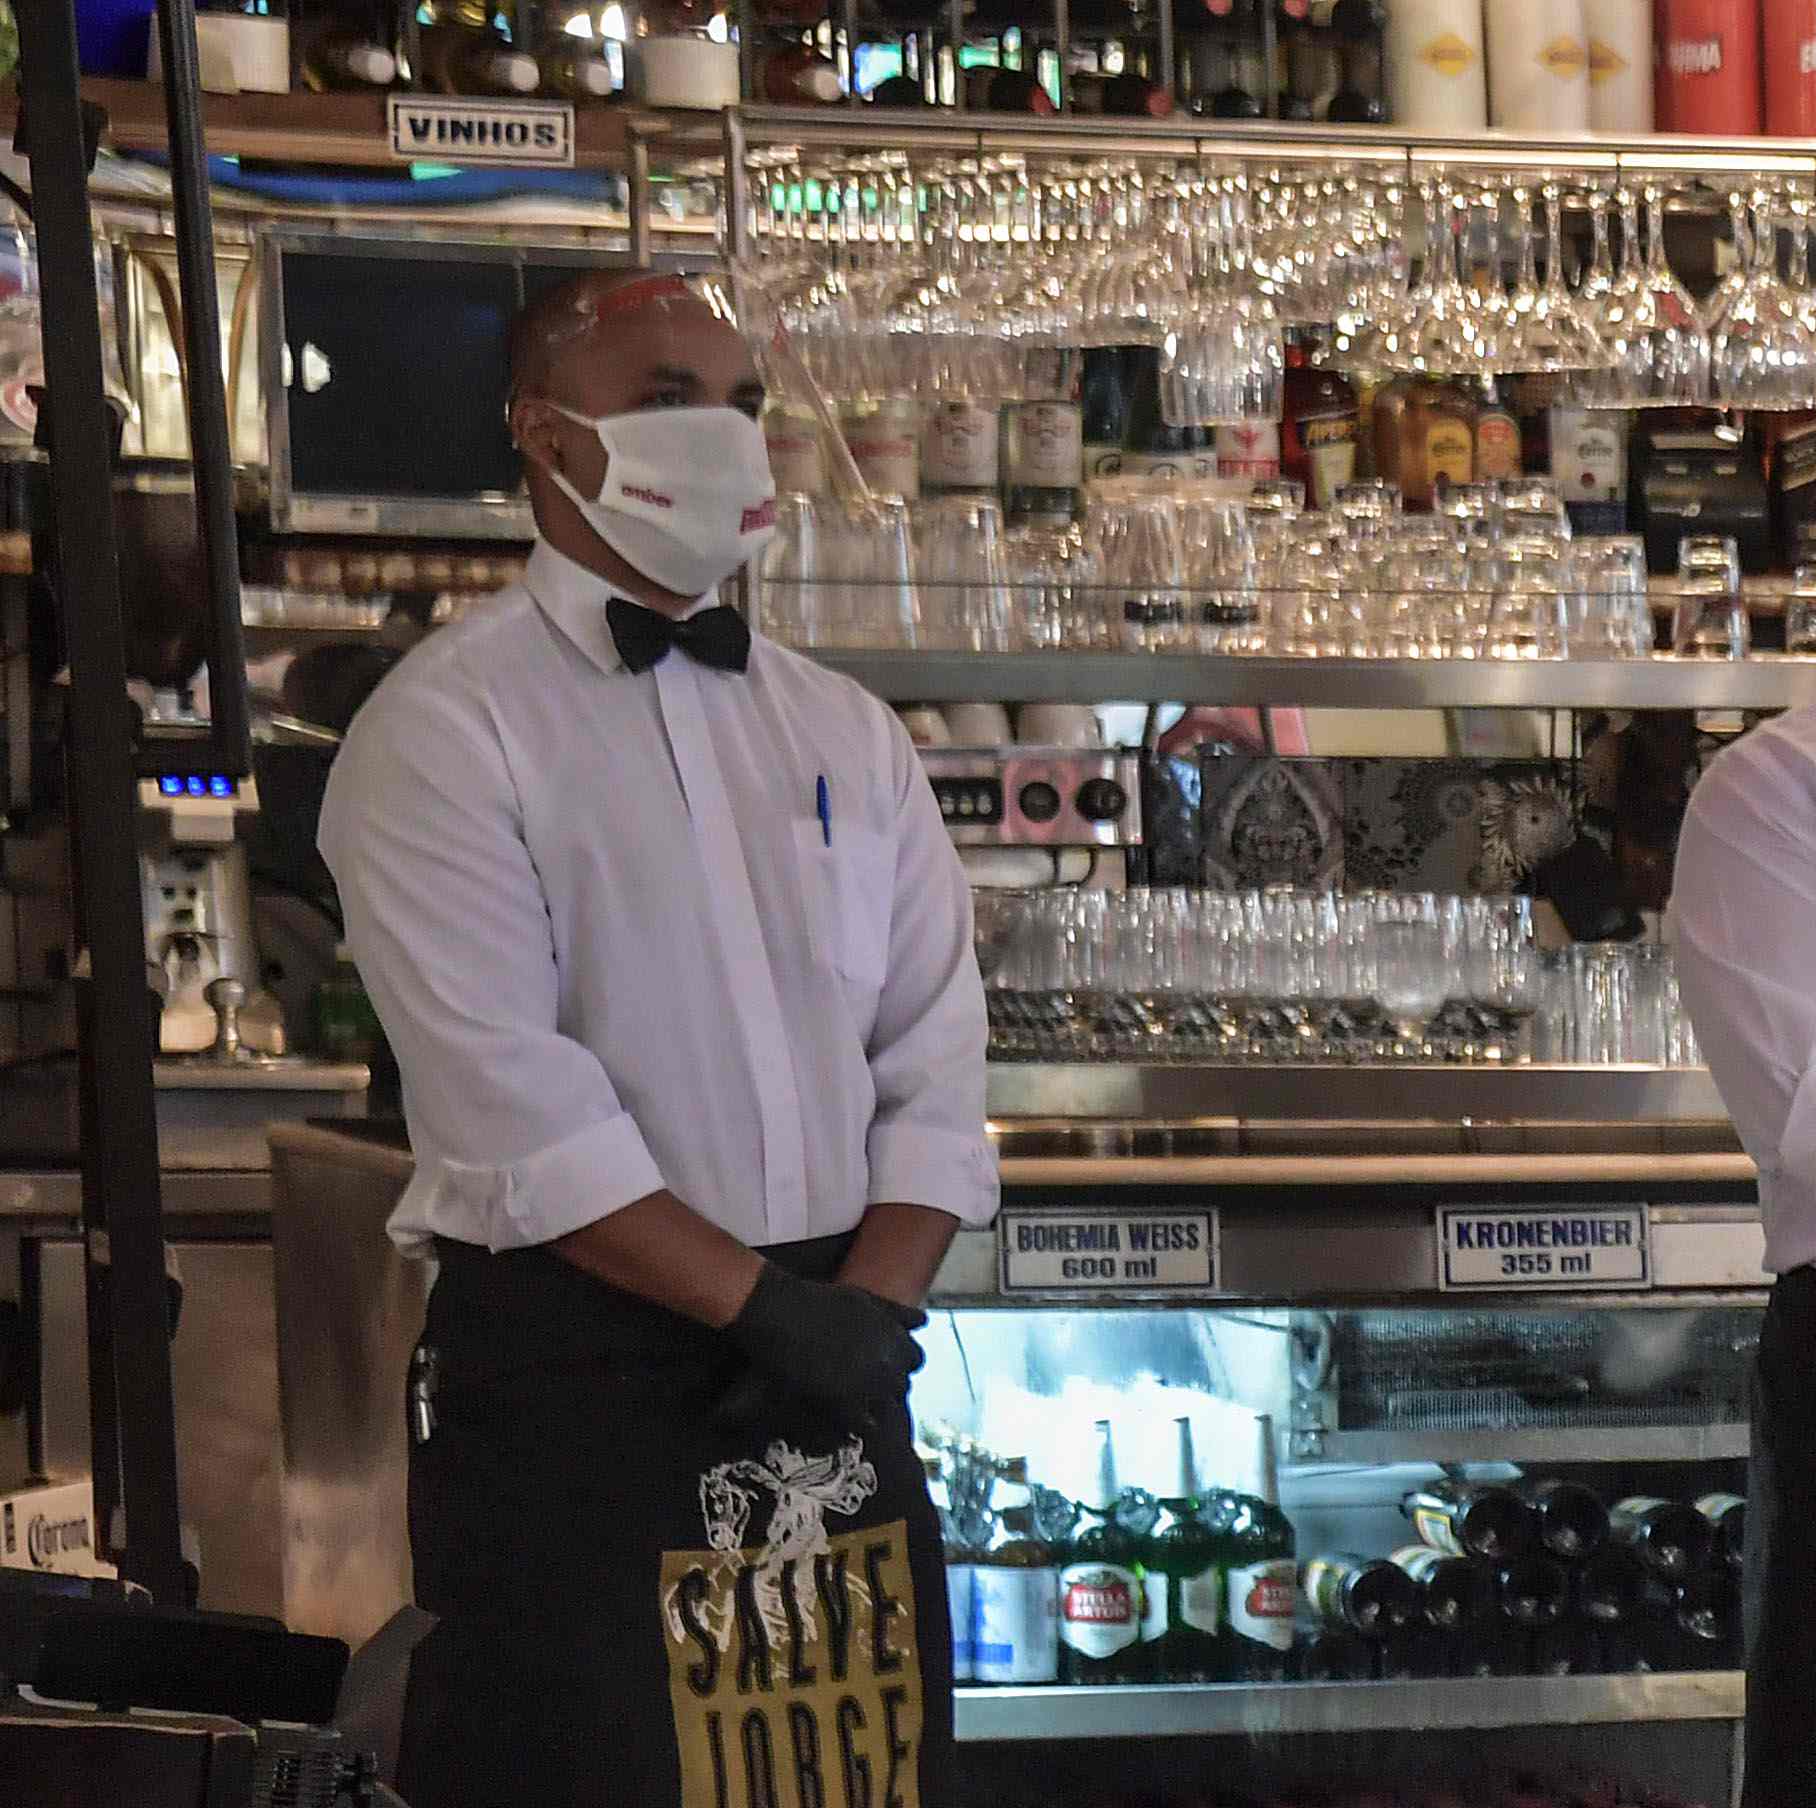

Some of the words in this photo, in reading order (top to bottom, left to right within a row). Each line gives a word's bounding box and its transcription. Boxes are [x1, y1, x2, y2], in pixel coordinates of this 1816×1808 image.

[408, 117, 556, 148] VINHOS
[1016, 1222, 1121, 1253] BOHEMIA
[1127, 1222, 1201, 1251] WEISS
[1455, 1219, 1634, 1250] KRONENBIER
[1061, 1256, 1117, 1279] 600
[1124, 1256, 1158, 1278] ml
[1501, 1252, 1552, 1275] 355
[1560, 1252, 1592, 1273] ml
[1071, 1590, 1127, 1606] STELLA
[1071, 1605, 1127, 1618] ARTOIS
[677, 1540, 905, 1699] SALVE
